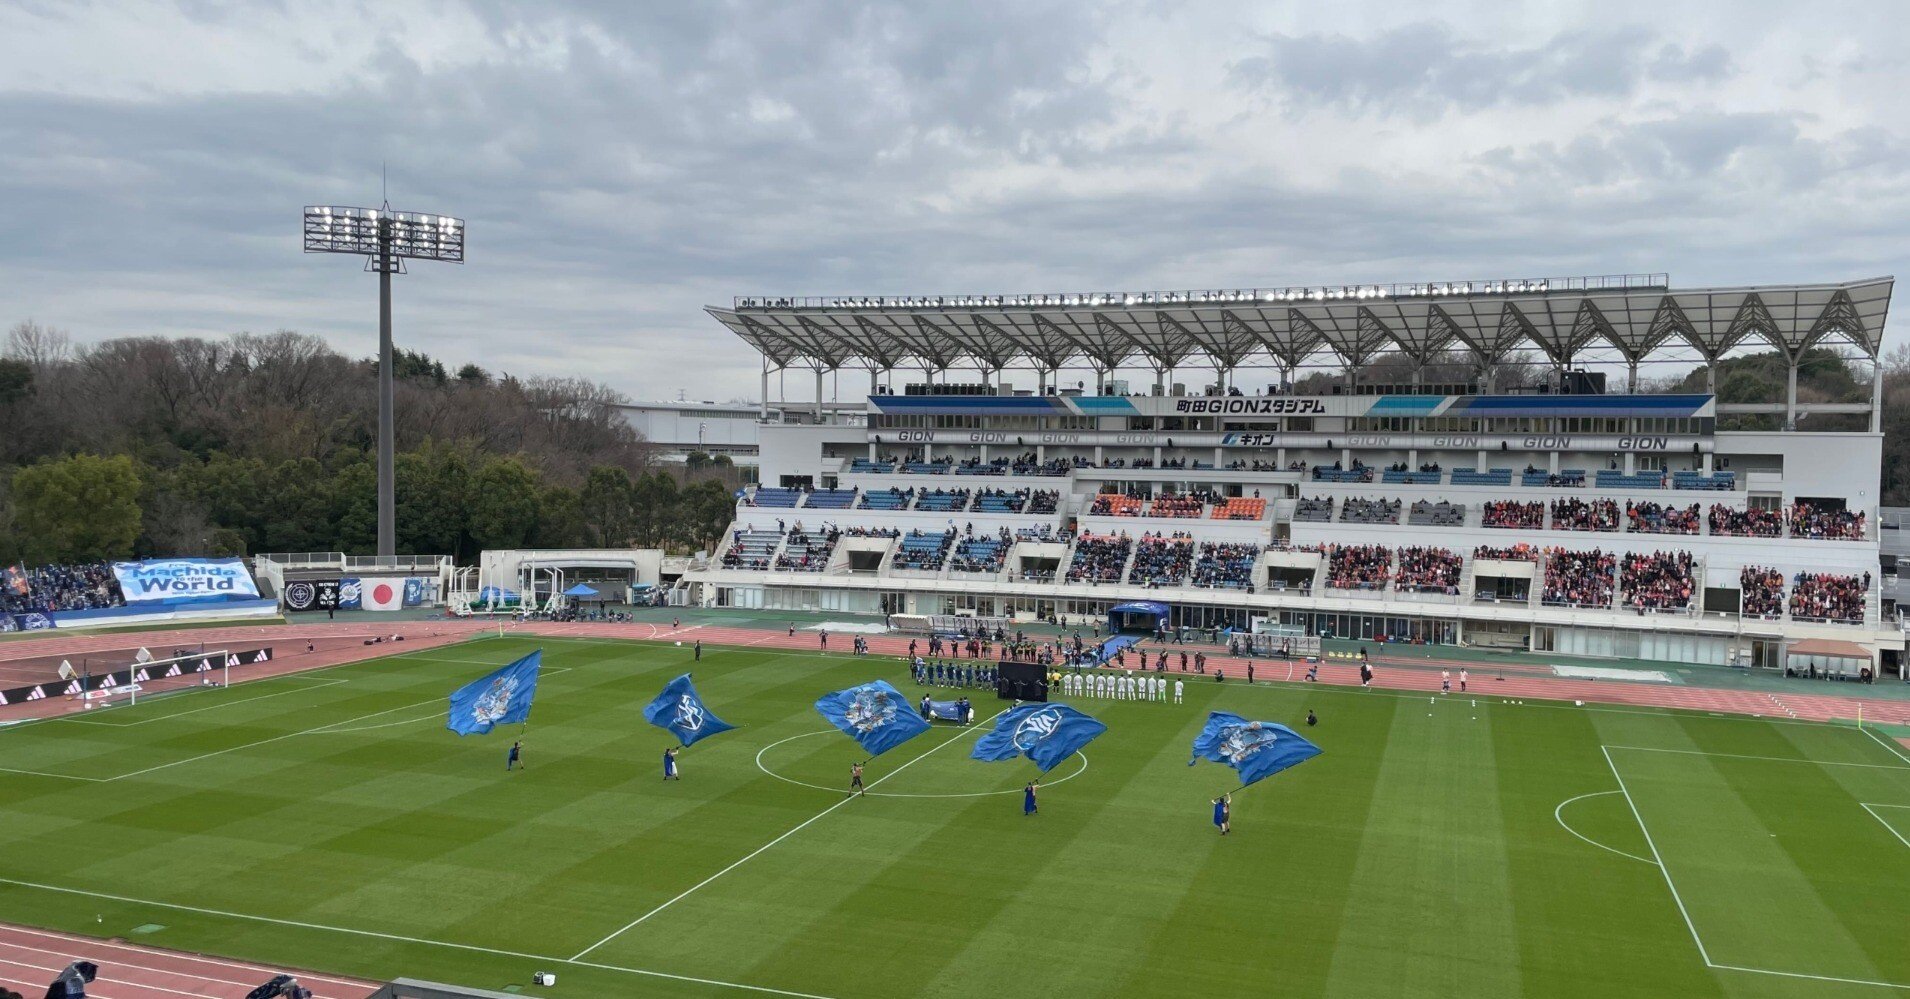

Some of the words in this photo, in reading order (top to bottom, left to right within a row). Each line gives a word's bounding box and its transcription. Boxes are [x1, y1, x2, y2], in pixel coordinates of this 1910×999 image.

[1176, 399, 1325, 414] 町田GIONスタジアム
[898, 431, 935, 442] GION
[970, 432, 1006, 443] GION
[1042, 433, 1079, 443] GION
[1116, 434, 1154, 444] GION
[1240, 433, 1275, 446] キオン
[1348, 435, 1391, 446] GION
[1433, 436, 1478, 448] GION
[1523, 436, 1571, 449] GION
[1617, 437, 1668, 450] GION
[132, 567, 236, 578] Machida
[138, 577, 234, 593] World
